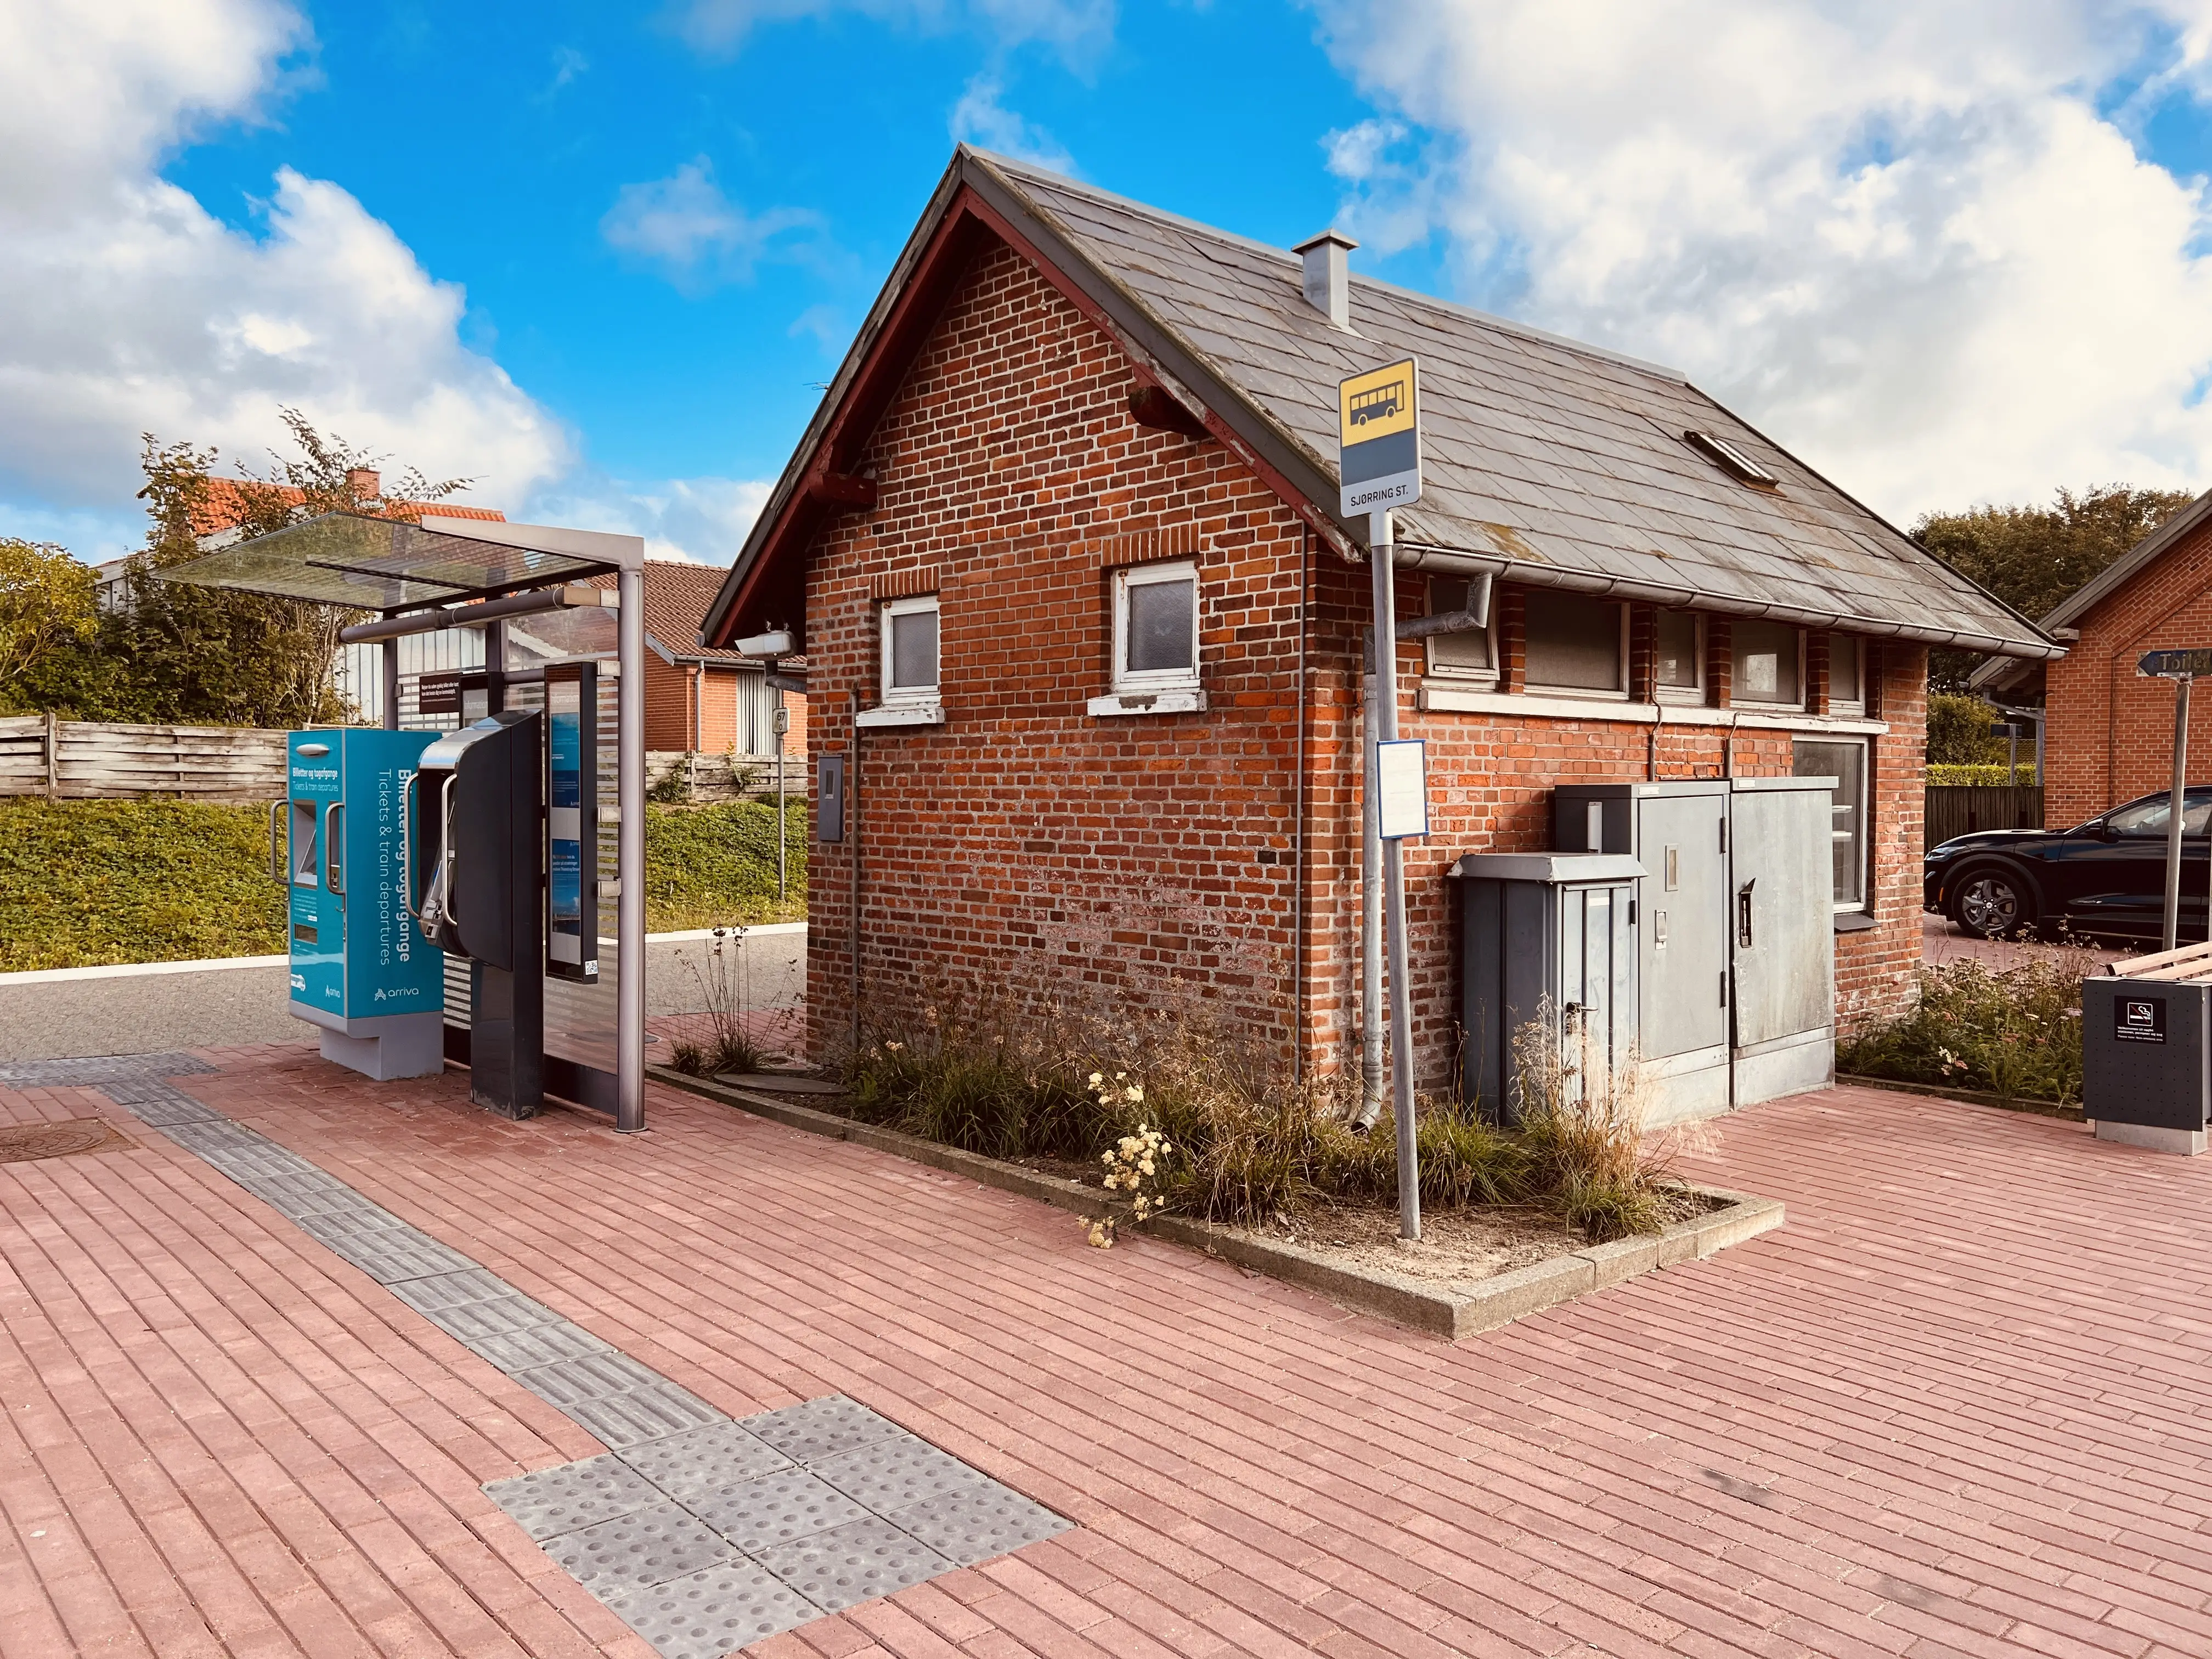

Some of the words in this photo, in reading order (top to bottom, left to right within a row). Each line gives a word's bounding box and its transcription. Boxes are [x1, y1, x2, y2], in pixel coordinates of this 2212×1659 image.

[1351, 488, 1393, 506] SJØRRING
[1396, 484, 1408, 496] ST.
[777, 712, 785, 721] 67
[379, 768, 392, 821] Tickets
[379, 826, 392, 837] &
[379, 840, 392, 877] train
[377, 881, 392, 966] departures
[388, 987, 419, 997] arriva
